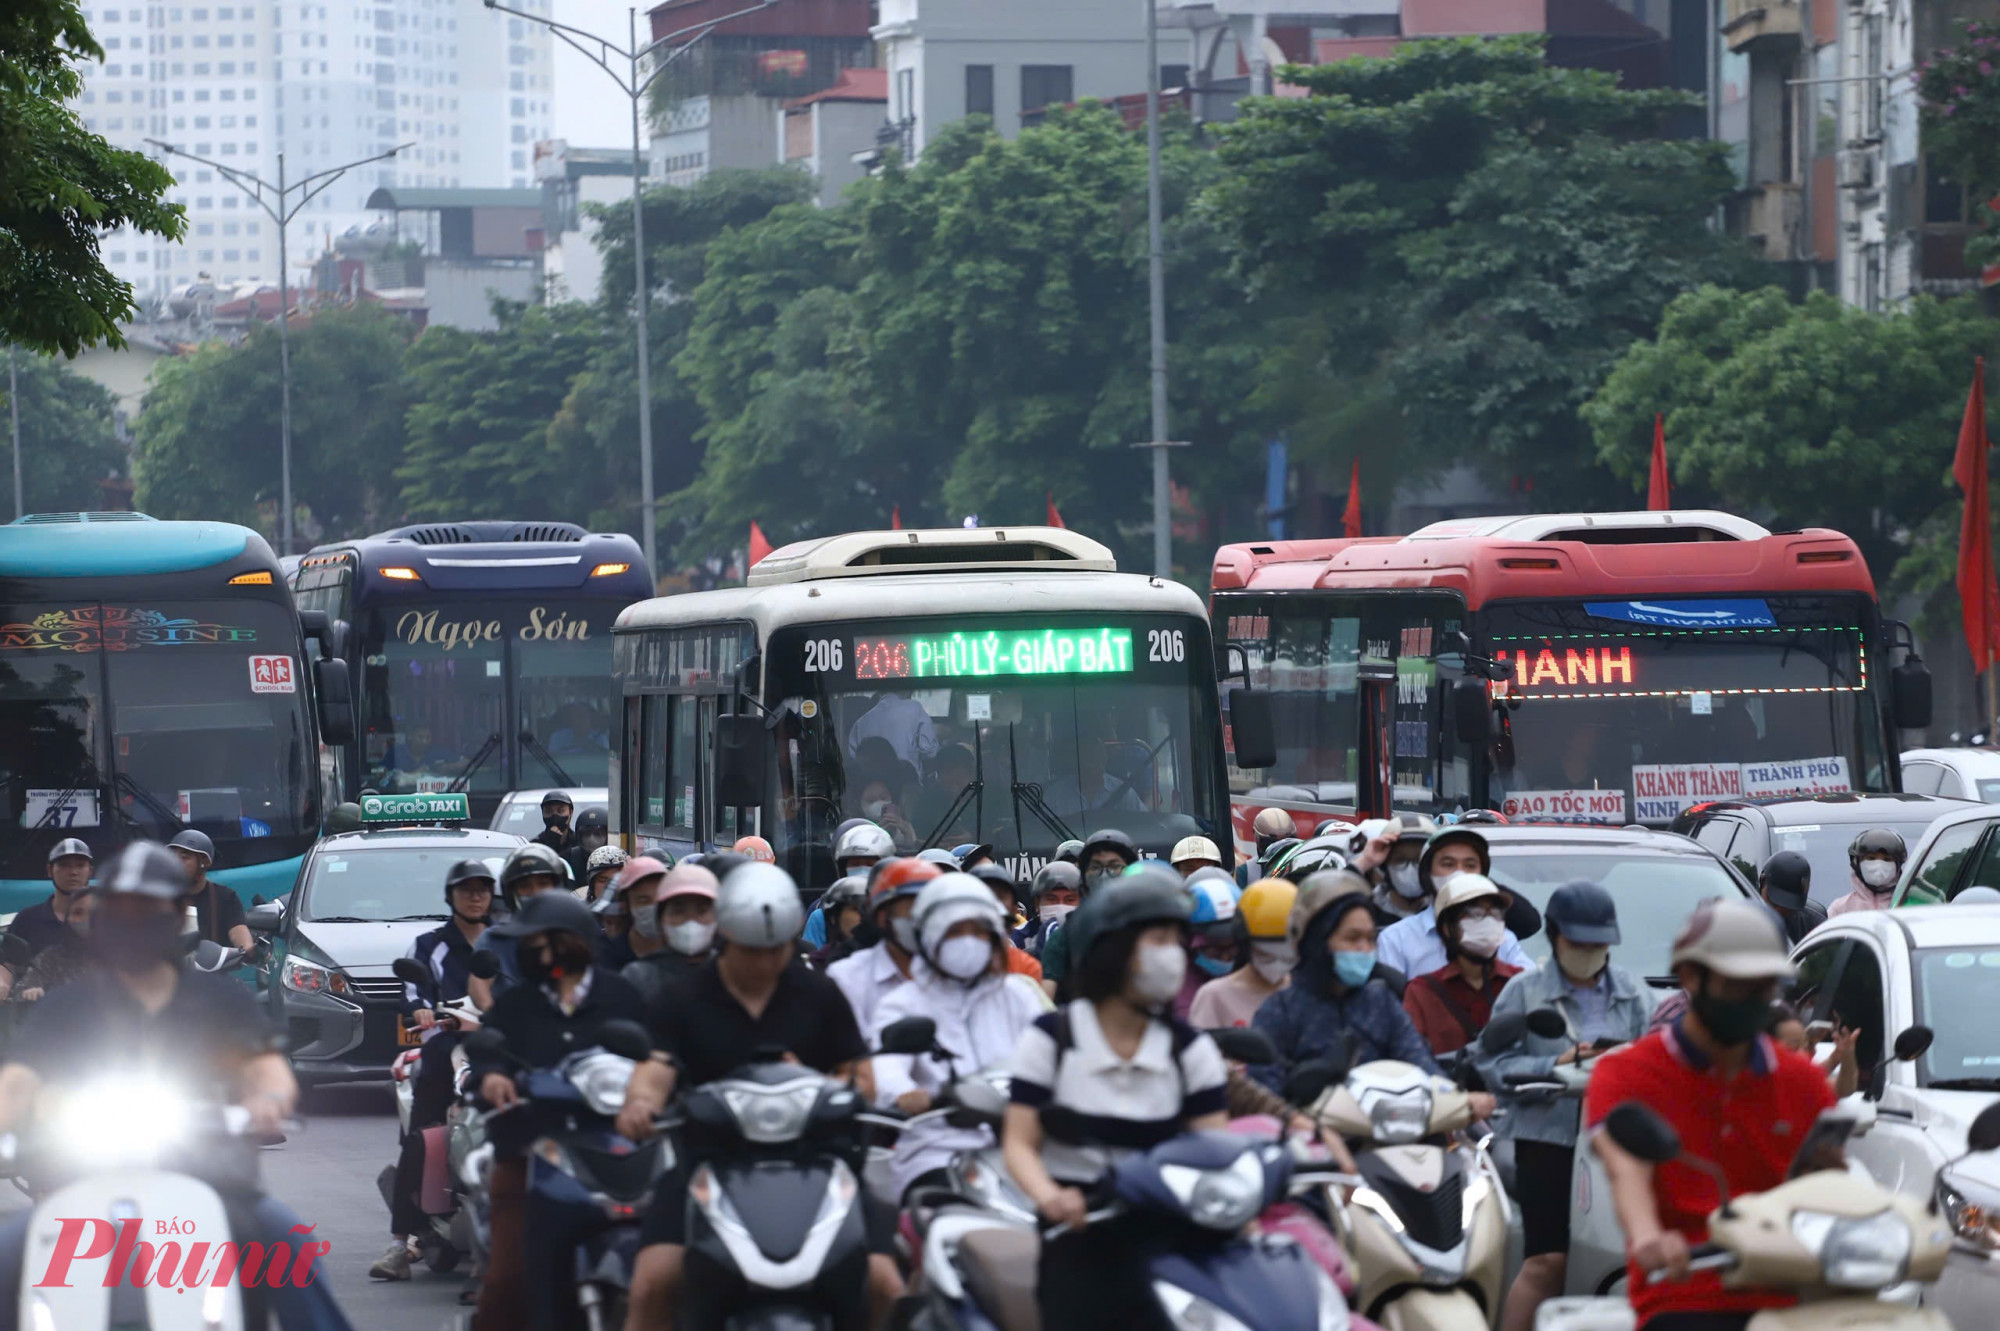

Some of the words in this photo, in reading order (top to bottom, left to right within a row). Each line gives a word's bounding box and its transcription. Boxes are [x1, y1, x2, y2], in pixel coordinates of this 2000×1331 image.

[396, 610, 501, 650] Ngọc
[1148, 629, 1185, 662] 206
[804, 639, 843, 672] 206
[856, 642, 910, 679] 206
[1080, 628, 1130, 673] BÁT
[1689, 763, 1741, 797] THÀNH
[1748, 764, 1804, 782] THÀNH
[1808, 757, 1840, 777] PHỐ
[1513, 796, 1546, 814] AO
[1550, 790, 1585, 813] TỐC
[1589, 791, 1622, 813] MỚI
[1637, 801, 1680, 818] NINH
[1003, 851, 1047, 882] VĂN
